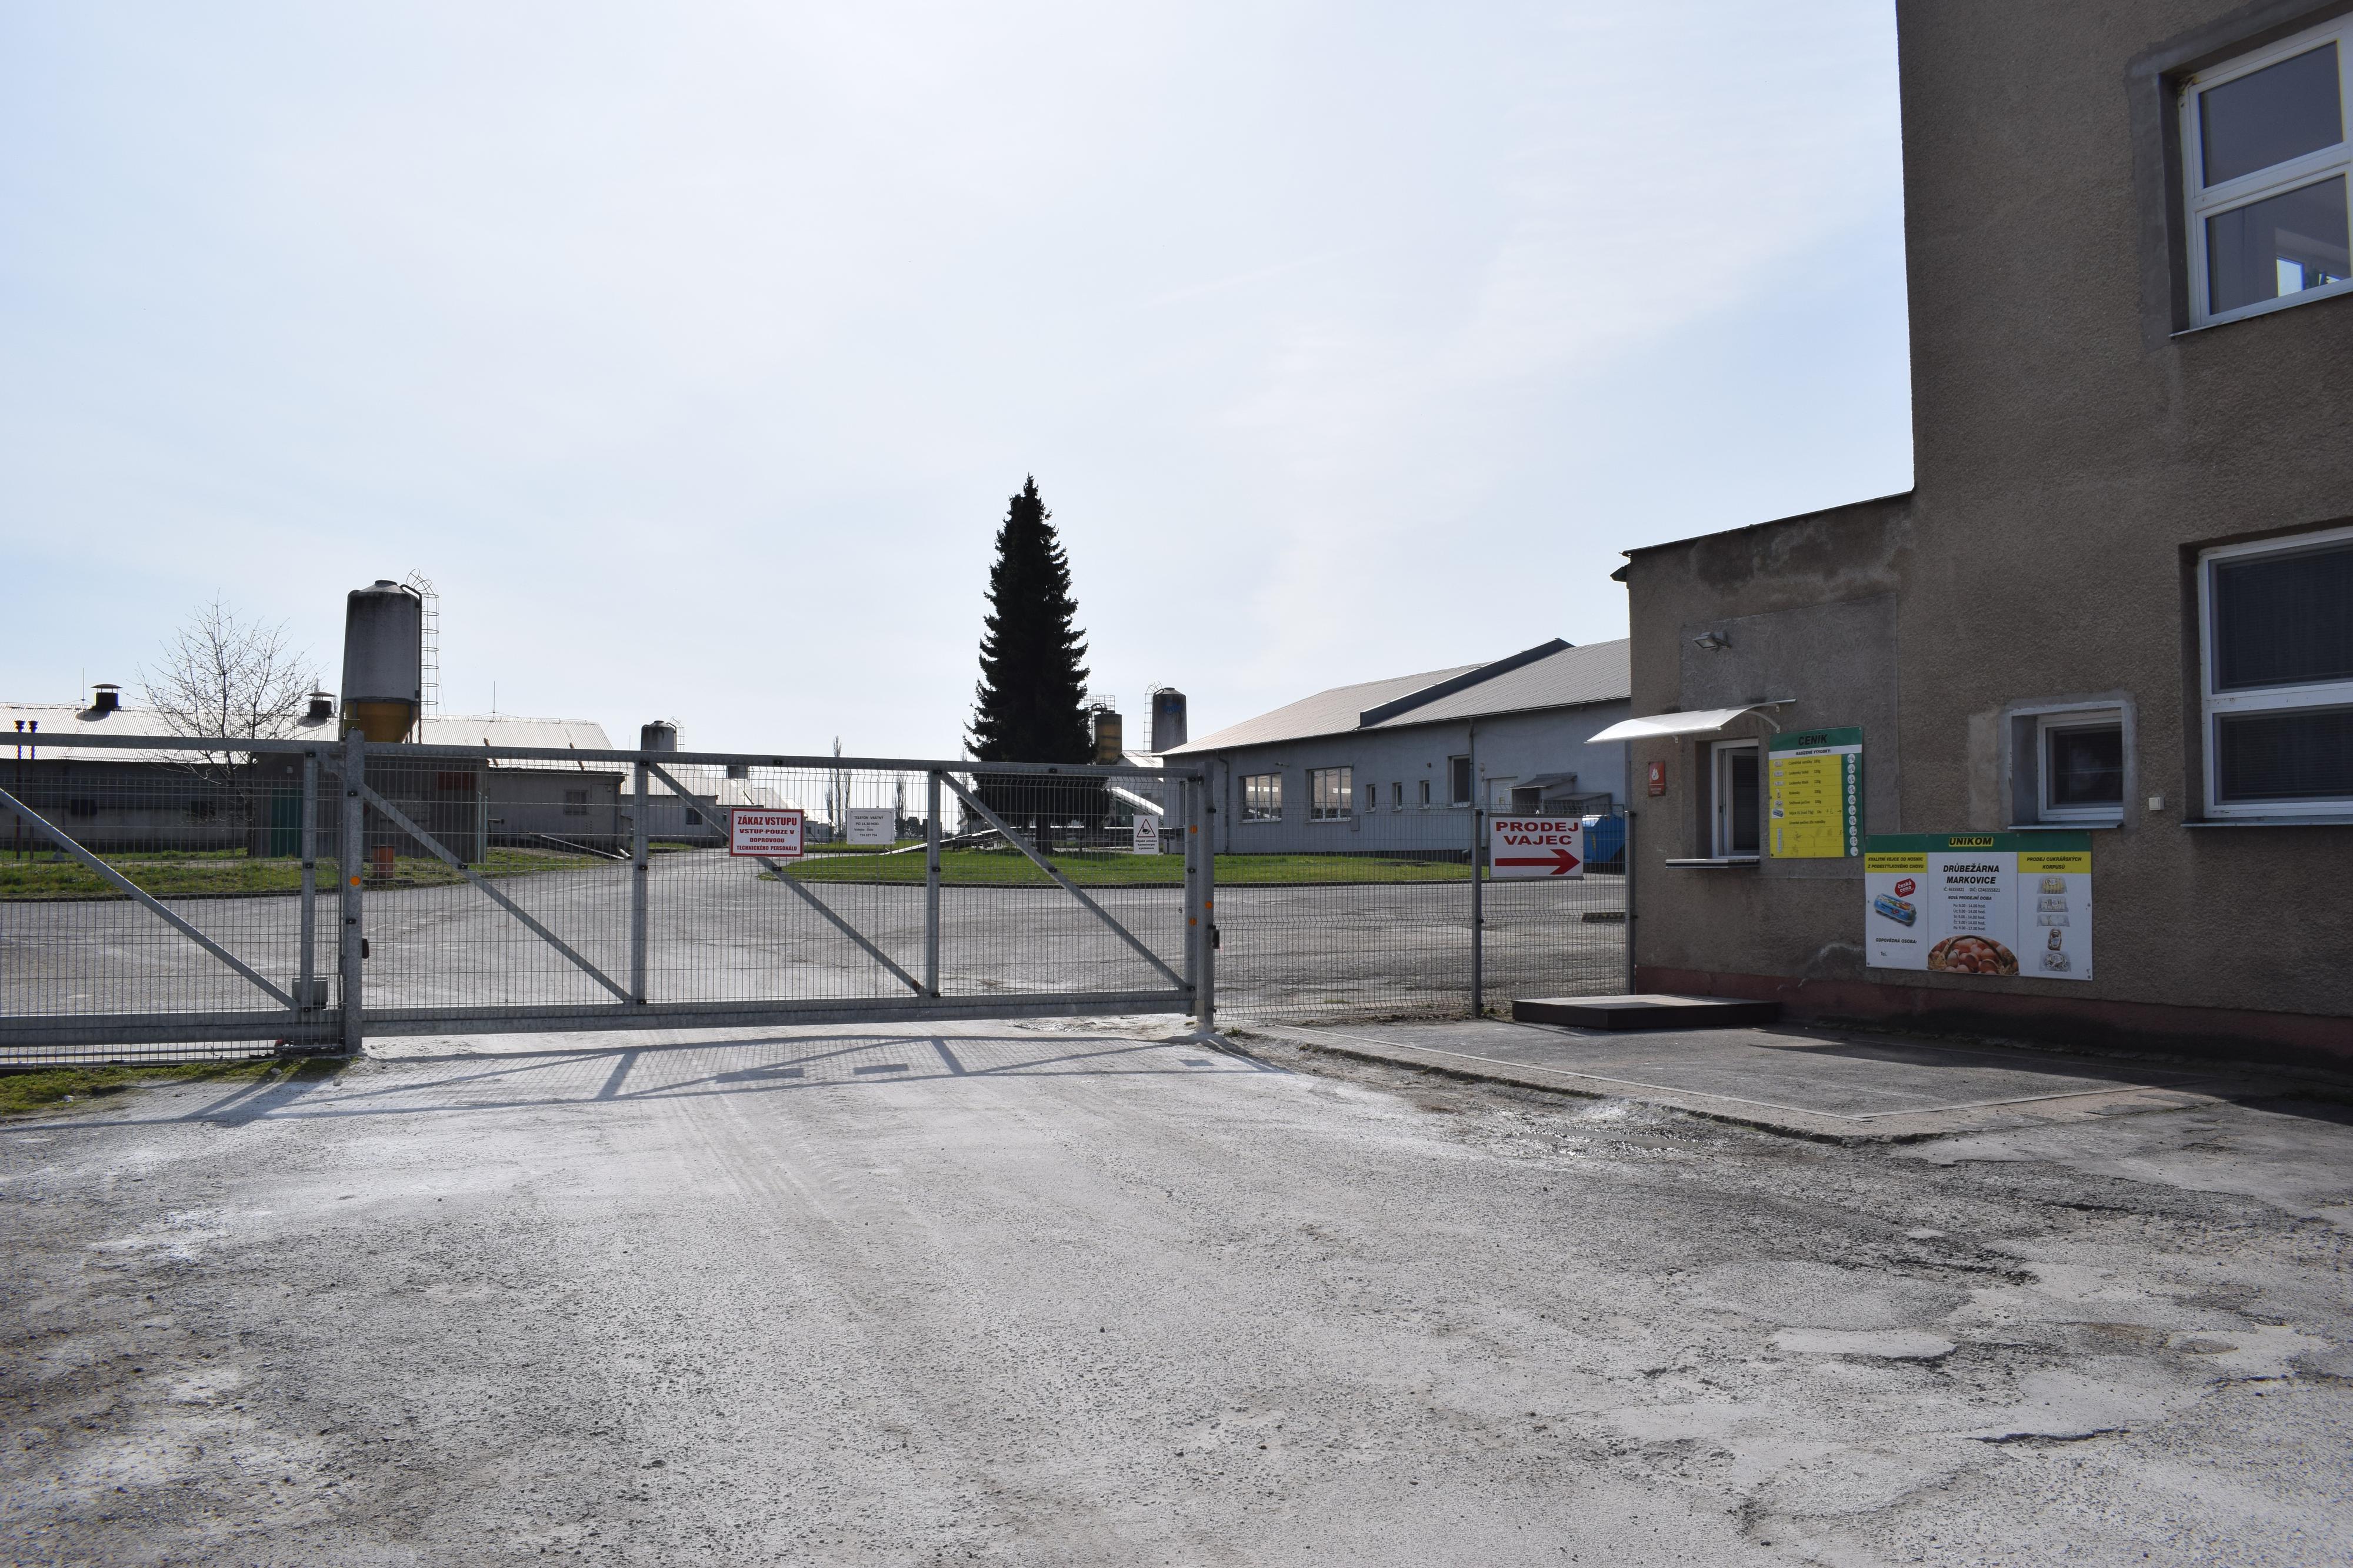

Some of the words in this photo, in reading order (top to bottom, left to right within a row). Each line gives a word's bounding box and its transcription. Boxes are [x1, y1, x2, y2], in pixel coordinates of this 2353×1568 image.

[1798, 733, 1828, 746] CENÍK
[738, 815, 763, 825] ZÁKAZ
[765, 817, 797, 826] VSTUPU
[1496, 822, 1579, 832] PRODEJ
[1504, 835, 1572, 845] VAJEC
[1949, 837, 1992, 846] UNIKOM
[1943, 863, 1999, 872] DRŮBEŽÁRNA
[1898, 880, 1912, 889] česká
